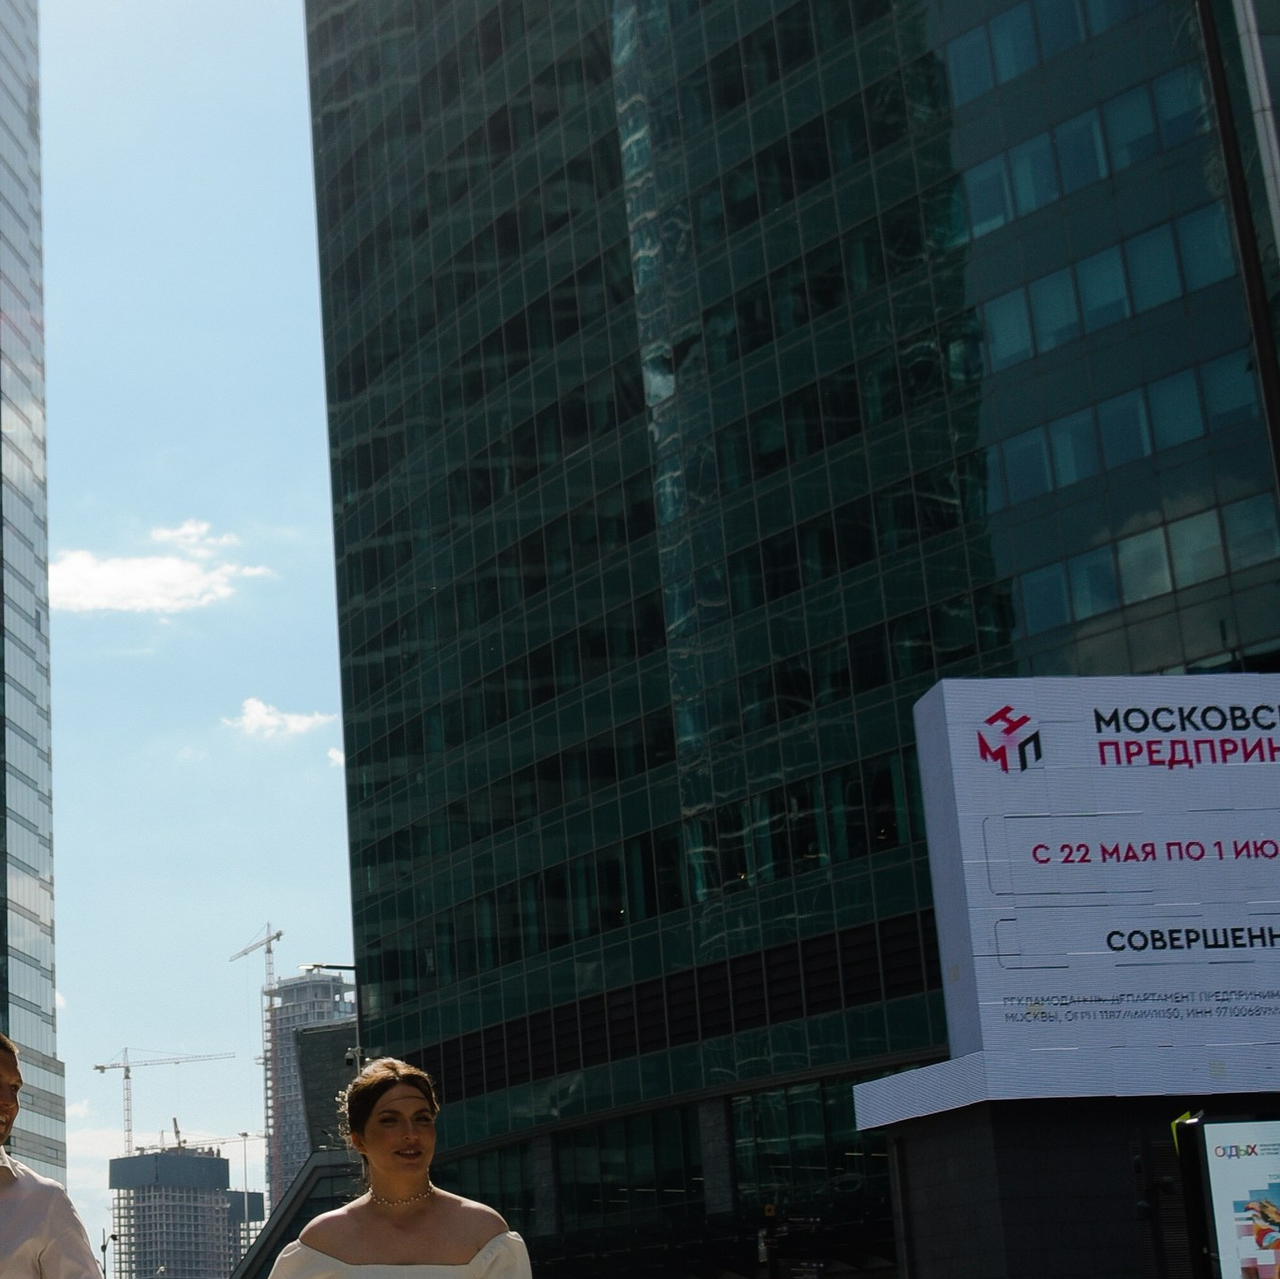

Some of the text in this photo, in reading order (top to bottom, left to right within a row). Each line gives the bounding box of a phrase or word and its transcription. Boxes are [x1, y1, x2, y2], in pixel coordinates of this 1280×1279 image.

[1093, 704, 1280, 734] МОСКОВС
[1032, 843, 1051, 864] С
[1060, 843, 1091, 864] 22
[1100, 841, 1157, 863] МАЯ
[1166, 840, 1205, 861] ПО
[1213, 840, 1224, 861] 1
